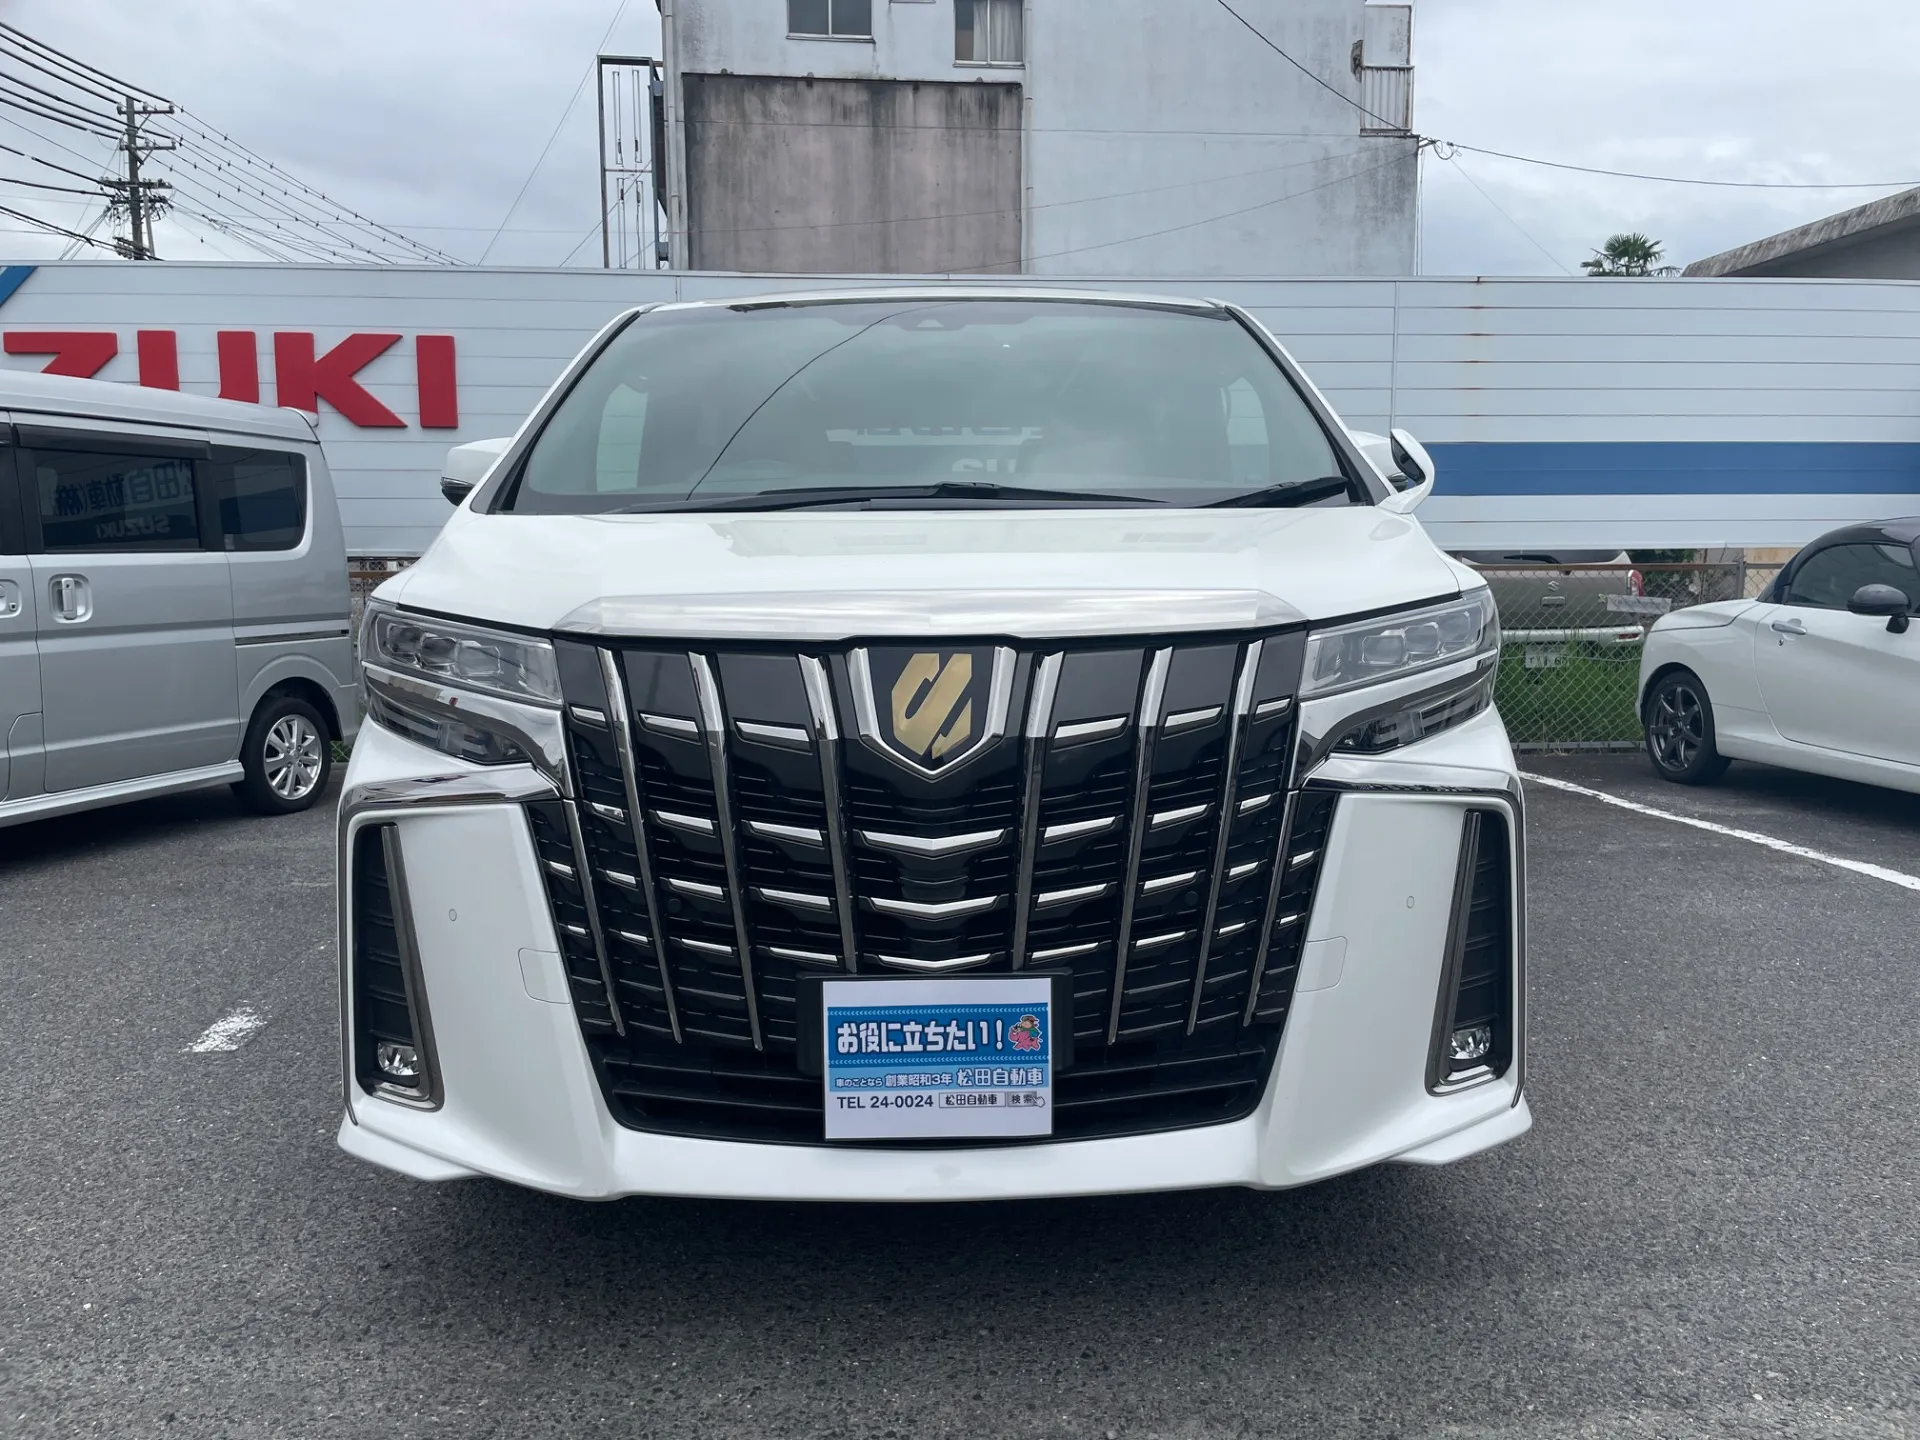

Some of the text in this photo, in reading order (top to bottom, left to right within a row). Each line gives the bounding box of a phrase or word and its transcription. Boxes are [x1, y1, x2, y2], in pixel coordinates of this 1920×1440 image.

[835, 1067, 1043, 1088] 車のことなら 創業昭和3年 松田自動車
[837, 1094, 934, 1109] TEL 24-0024
[945, 1093, 998, 1106] 松田自動車
